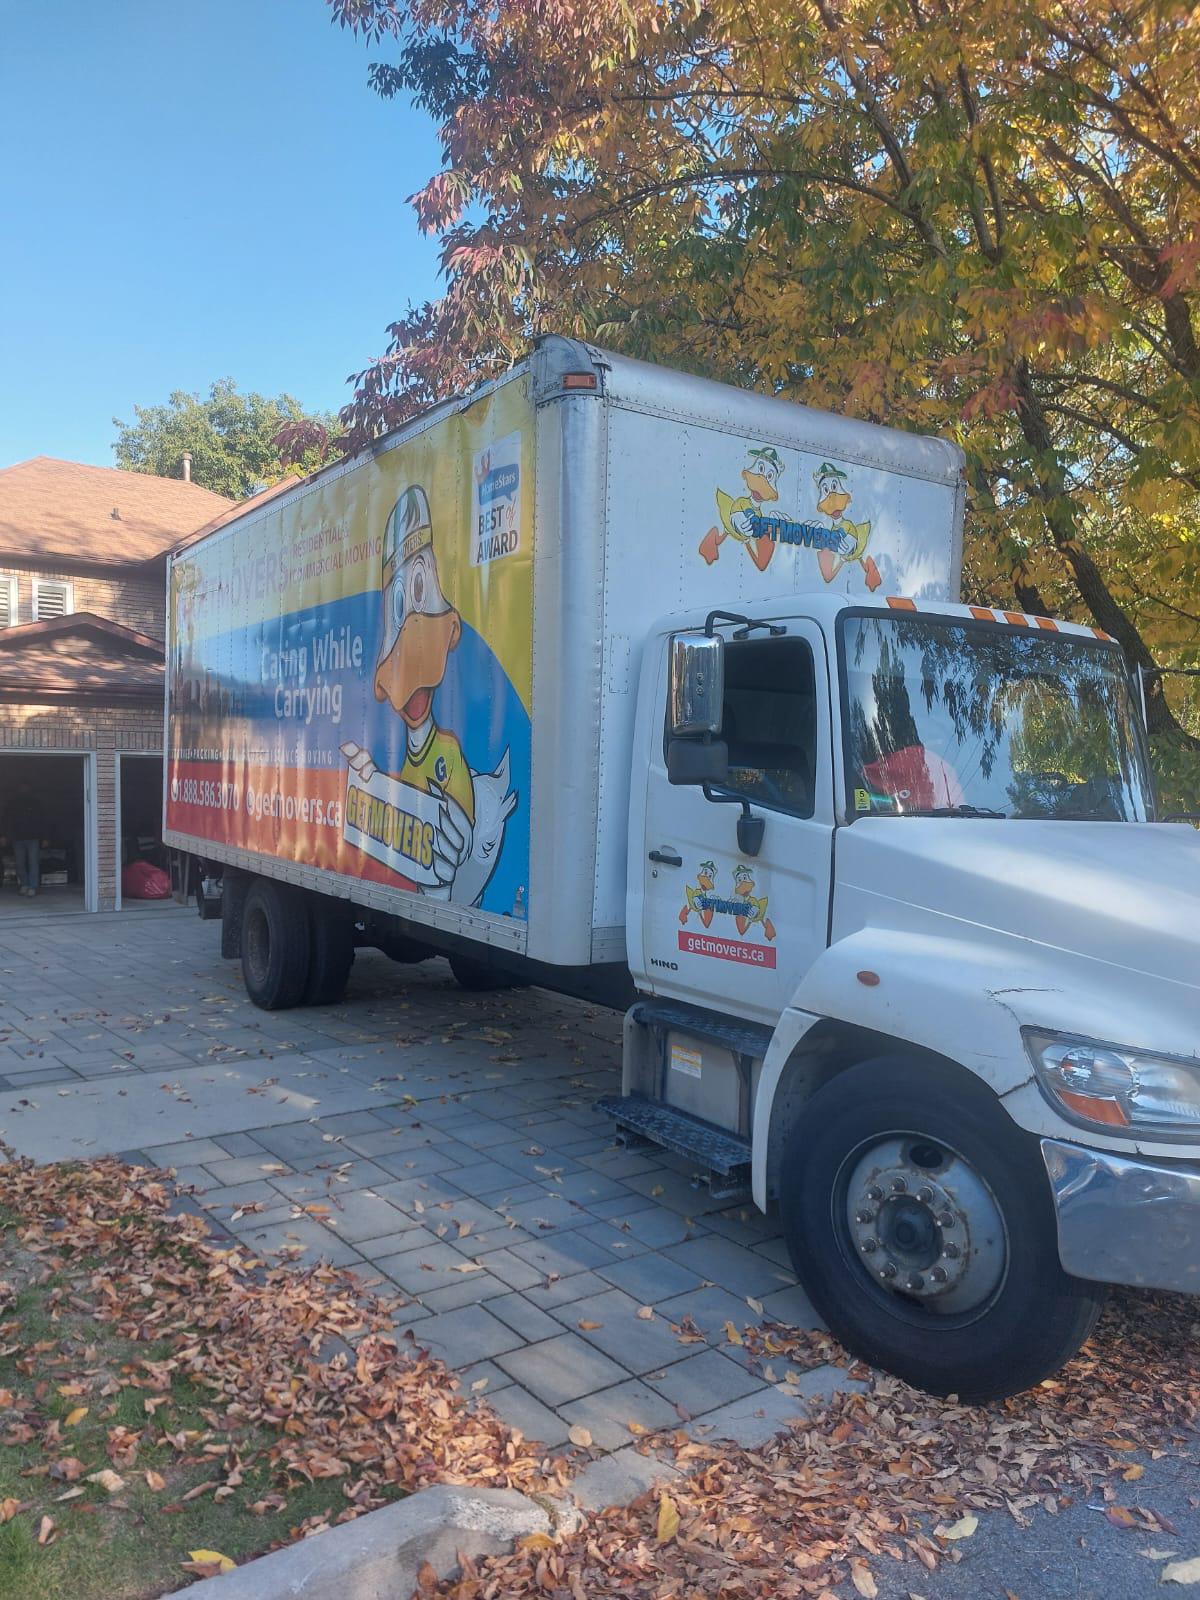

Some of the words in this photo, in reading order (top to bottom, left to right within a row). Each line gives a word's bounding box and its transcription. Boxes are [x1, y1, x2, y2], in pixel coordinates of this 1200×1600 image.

[478, 504, 504, 536] BEST
[505, 496, 517, 528] of
[345, 536, 382, 566] MOVING
[477, 530, 518, 563] AWARD
[262, 641, 307, 684] Caring
[312, 625, 363, 673] While
[274, 675, 344, 725] Carrying
[434, 756, 447, 782] G
[178, 777, 240, 811] 1.888.586.3070
[256, 790, 343, 828] getmovers.ca
[650, 957, 679, 971] HINO
[687, 937, 765, 962] getmovers.ca
